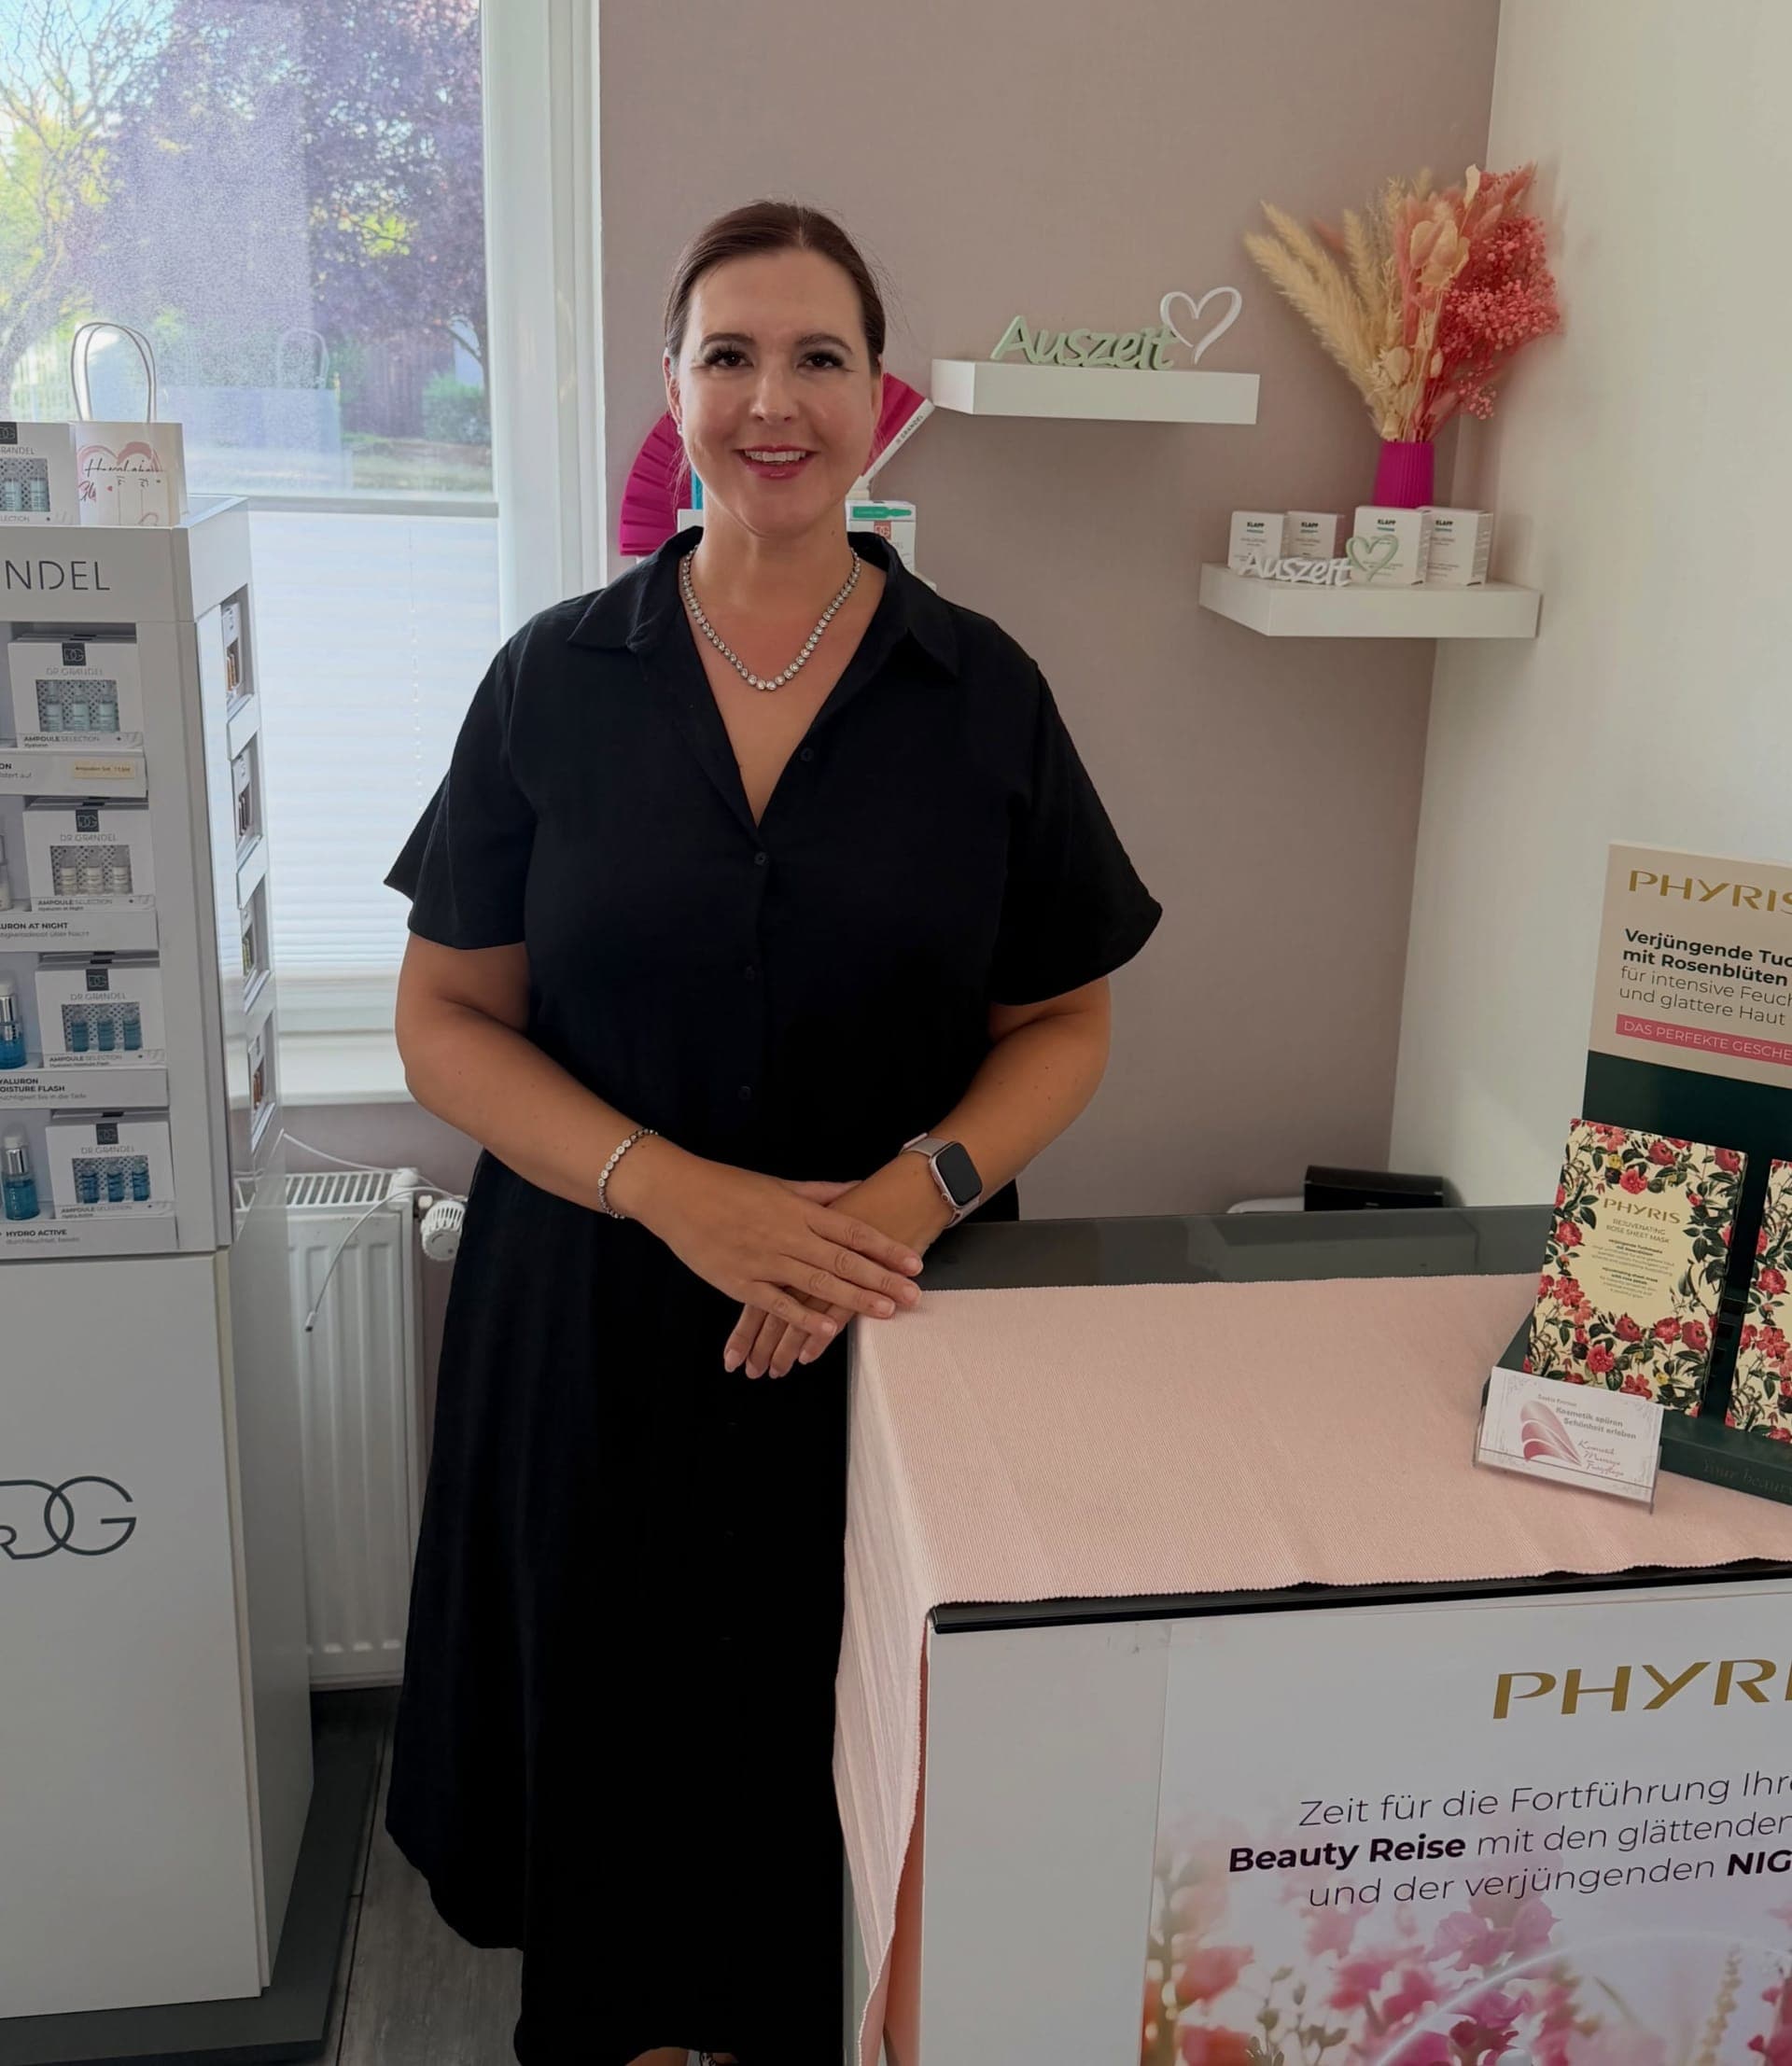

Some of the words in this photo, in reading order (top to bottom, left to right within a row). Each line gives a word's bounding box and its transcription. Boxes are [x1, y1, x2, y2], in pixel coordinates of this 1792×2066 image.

[989, 314, 1179, 370] Auszeit
[1377, 518, 1396, 526] KLAPP
[5, 560, 110, 591] NDEL
[1239, 550, 1353, 587] Auszeit
[28, 922, 40, 930] AT
[42, 921, 69, 929] NIGHT
[1625, 928, 1753, 960] Verjüngende
[1621, 965, 1646, 983] für
[1651, 970, 1734, 998] intensive
[1623, 950, 1658, 966] mit
[1661, 954, 1787, 986] Rosenblüten
[1619, 986, 1656, 1003] und
[1660, 993, 1733, 1017] glattere
[1740, 1005, 1785, 1026] Haut
[1623, 1021, 1652, 1036] DAS
[1656, 1027, 1729, 1050] PERFEKTE
[1603, 1198, 1681, 1225] PHYRIS
[6, 1229, 36, 1238] HYDRO
[38, 1228, 68, 1236] ACTIVE
[1606, 1224, 1625, 1235] ROSE
[1626, 1228, 1648, 1239] SHEET
[1650, 1234, 1670, 1244] MASK
[1556, 1407, 1593, 1421] Kosmetik
[1595, 1416, 1623, 1428] spüren
[1563, 1417, 1604, 1432] Schönheit
[1606, 1428, 1637, 1440] erleben
[1298, 1797, 1369, 1826] Zeit
[1381, 1794, 1432, 1821] für
[1442, 1790, 1499, 1817] die
[1511, 1777, 1730, 1814] Fortführung
[1743, 1770, 1792, 1796] Ihr
[1228, 1840, 1359, 1873] Beauty
[1369, 1833, 1466, 1864] Reise
[1477, 1829, 1534, 1857] mit
[1545, 1823, 1607, 1852] den
[1309, 1878, 1381, 1907] und
[1393, 1873, 1454, 1903] der
[1465, 1856, 1715, 1900] verjüngenden
[1727, 1850, 1792, 1878] NIG
